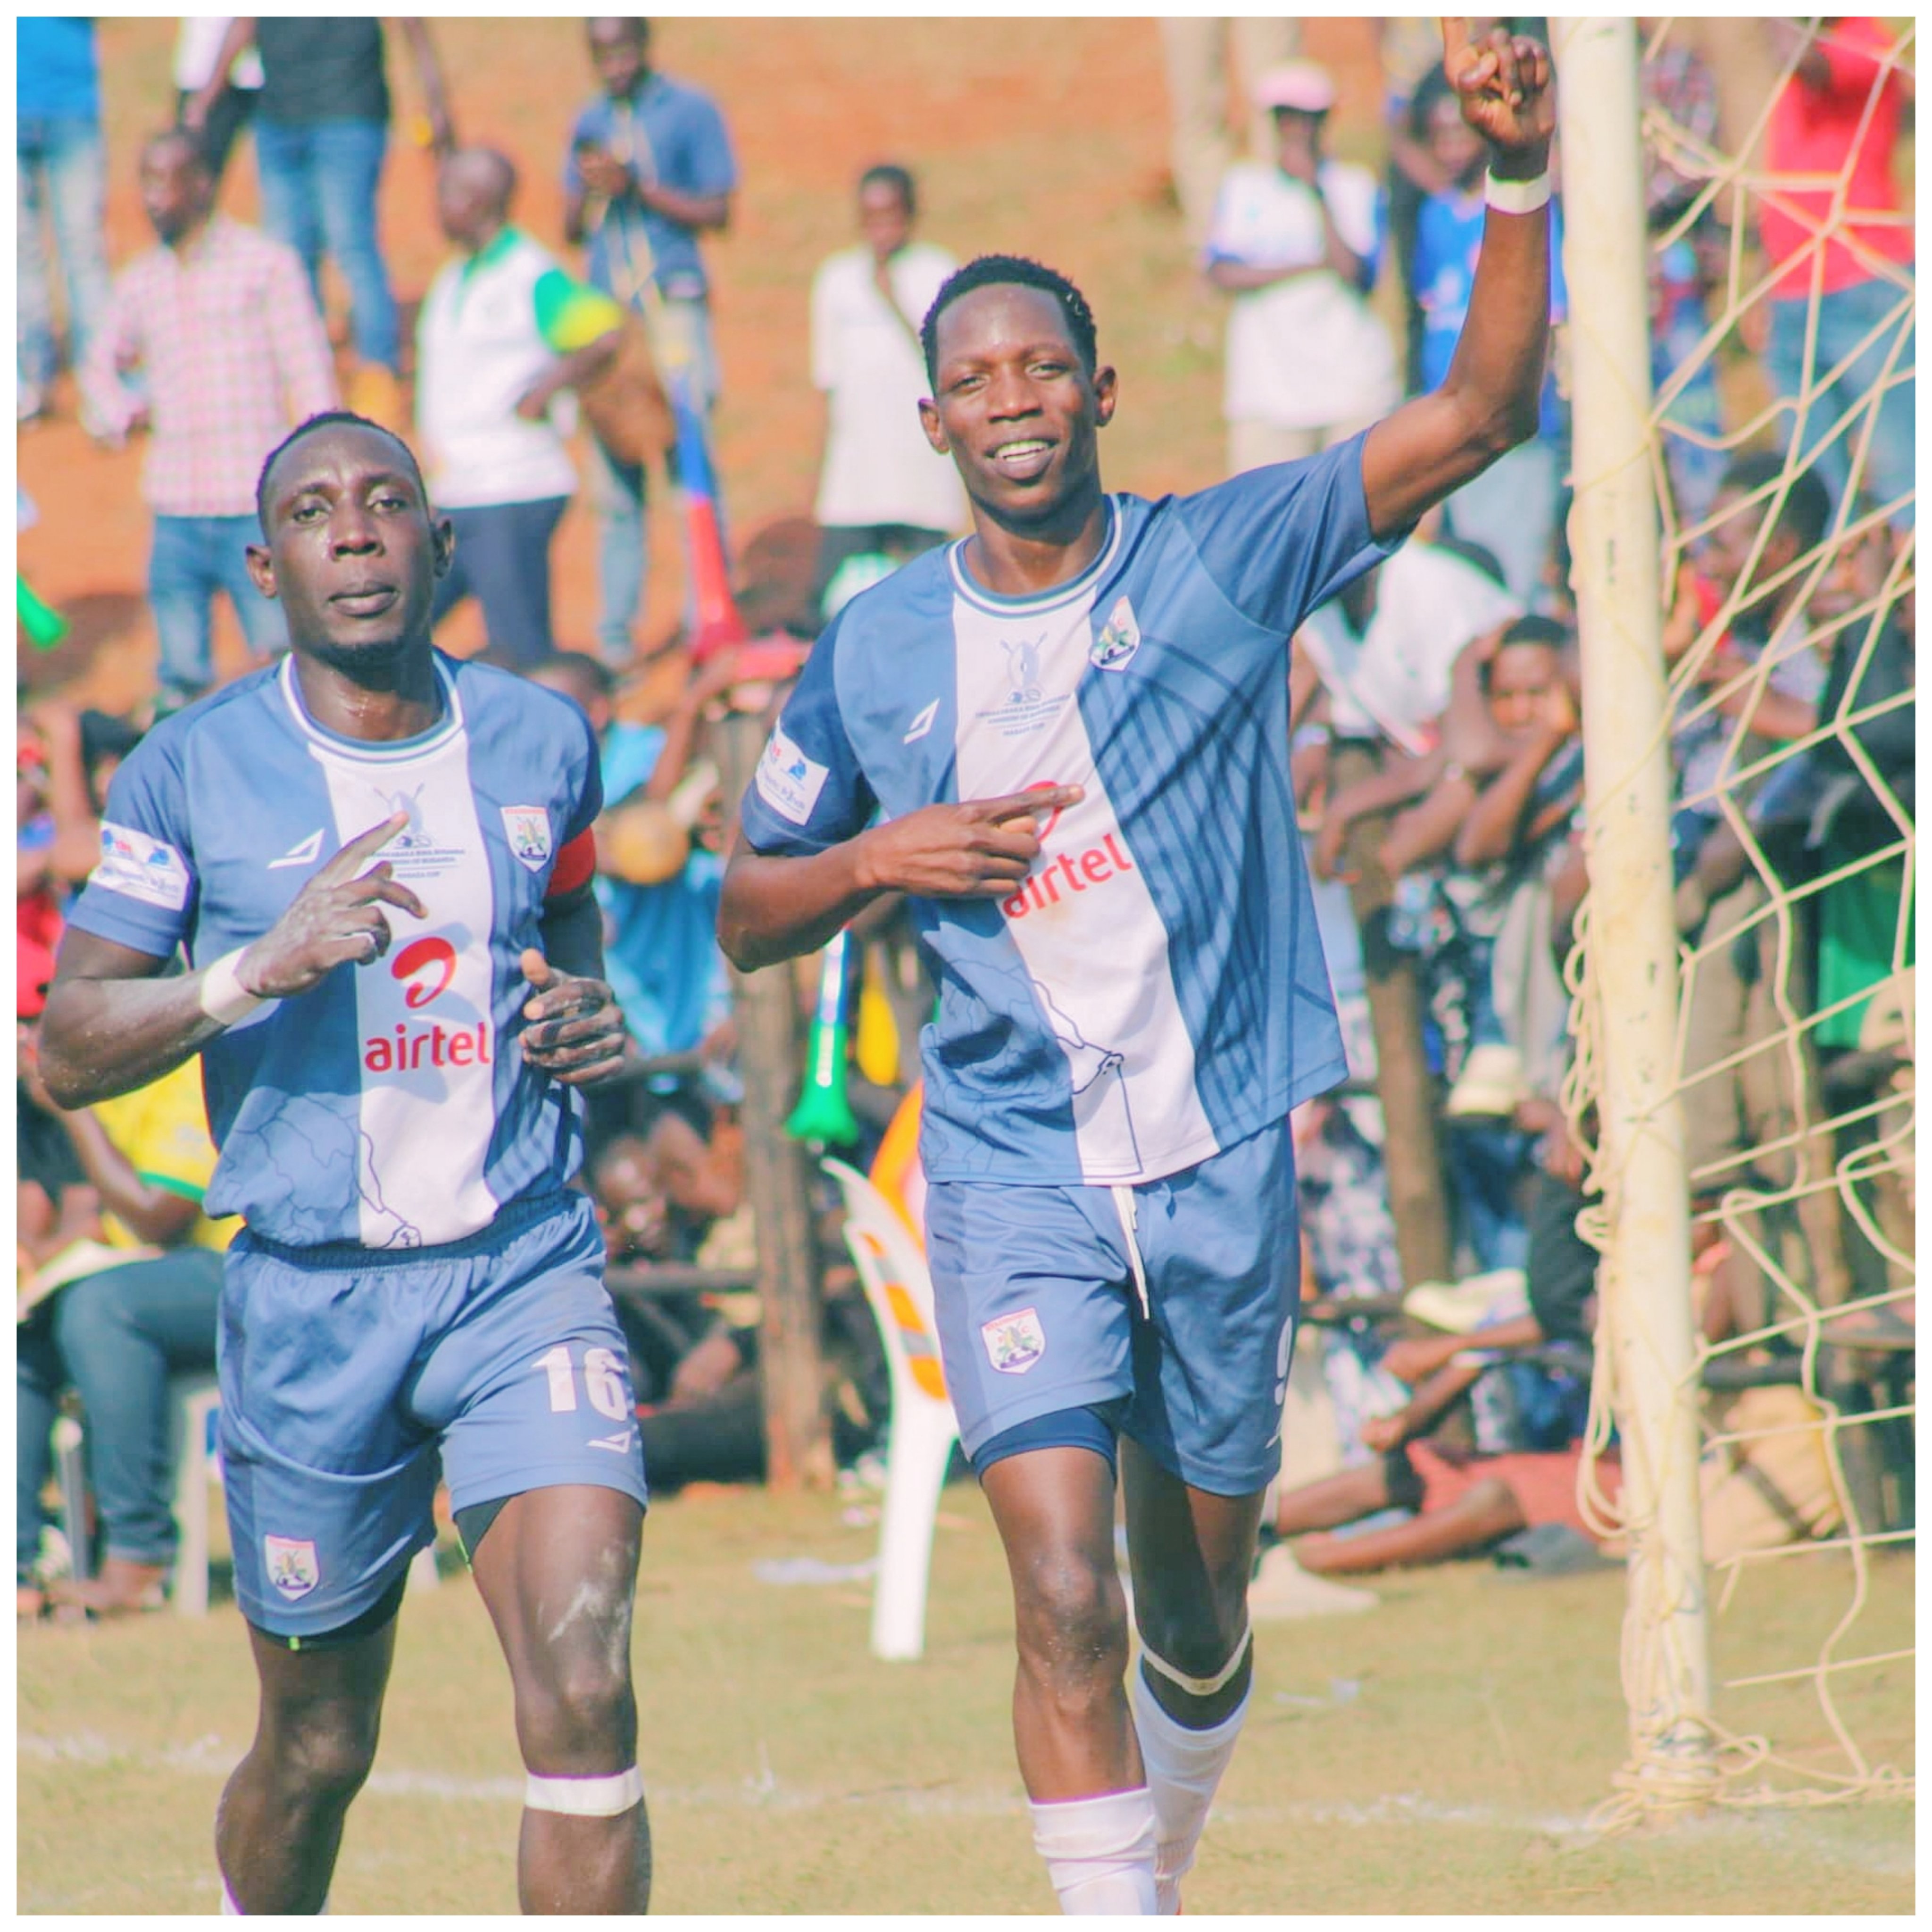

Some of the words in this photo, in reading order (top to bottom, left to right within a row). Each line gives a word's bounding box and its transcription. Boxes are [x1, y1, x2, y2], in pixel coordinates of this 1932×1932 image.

[1003, 833, 1132, 918] airtel
[365, 1022, 490, 1072] airtel
[532, 1346, 630, 1422] 16
